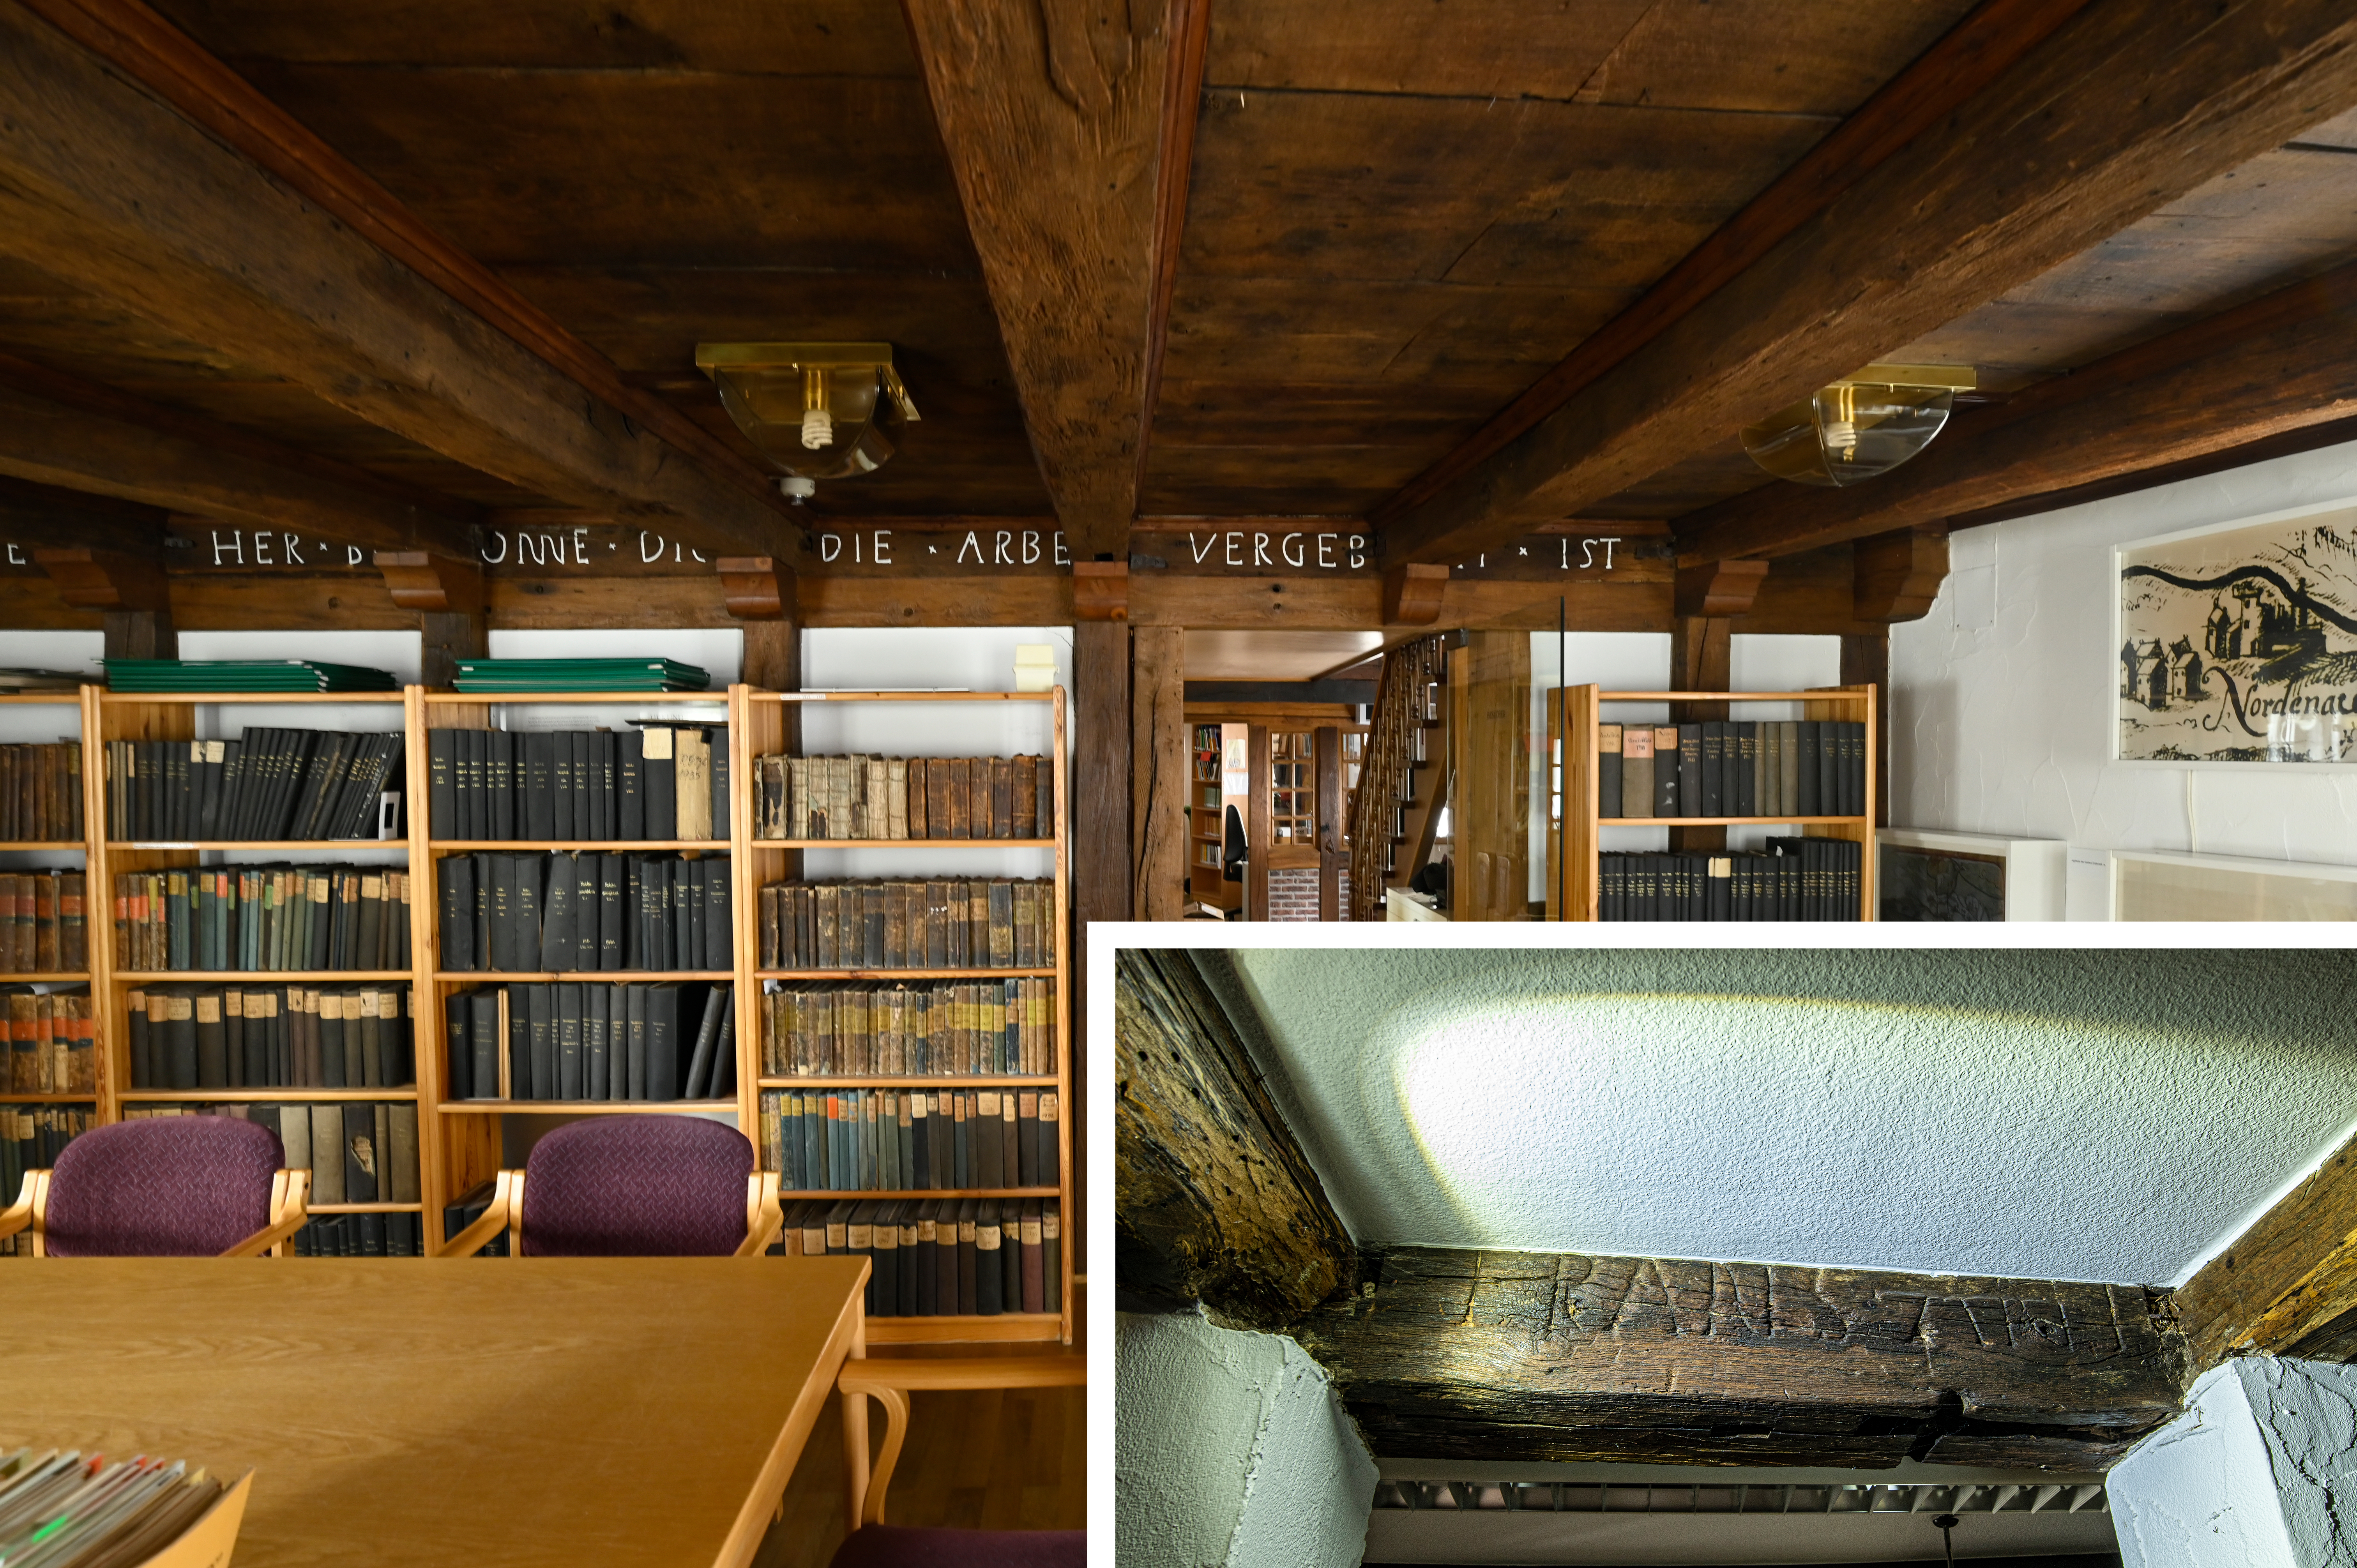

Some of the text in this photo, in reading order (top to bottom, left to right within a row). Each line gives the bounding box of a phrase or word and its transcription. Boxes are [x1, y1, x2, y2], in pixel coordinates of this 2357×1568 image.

[212, 530, 305, 565] HER
[822, 530, 892, 564] DIE
[957, 530, 1071, 565] ARBE
[1189, 532, 1365, 569] VERGEB
[1561, 538, 1621, 569] IST
